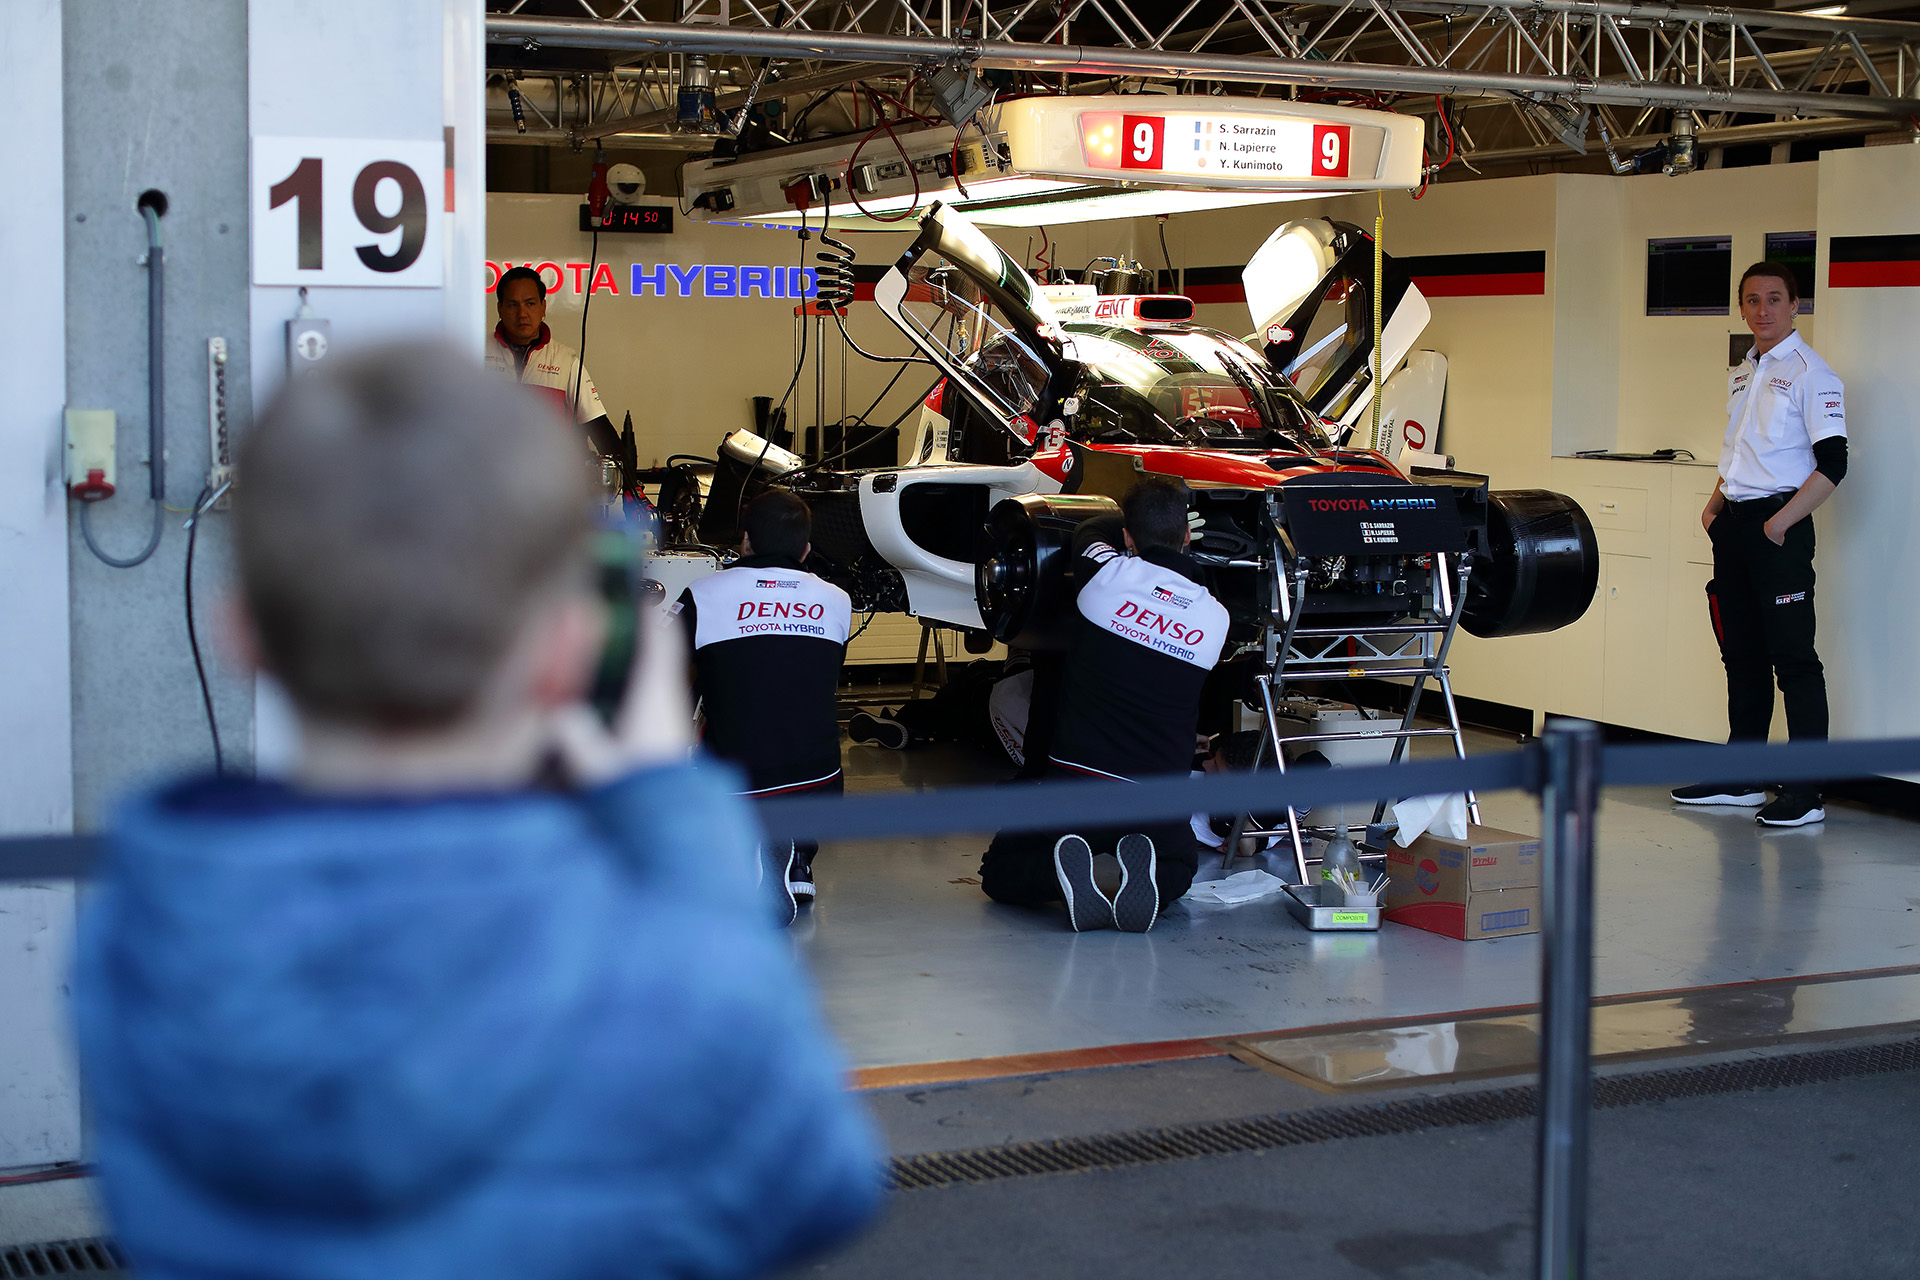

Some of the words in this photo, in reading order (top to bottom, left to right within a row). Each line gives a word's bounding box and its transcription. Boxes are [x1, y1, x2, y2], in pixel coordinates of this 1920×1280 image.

[1219, 124, 1230, 134] S.
[1233, 125, 1276, 136] Sarrazin
[1132, 122, 1154, 162] 9
[1219, 141, 1230, 151] N.
[1233, 142, 1276, 155] Lapierre
[1321, 132, 1341, 170] 9
[1220, 159, 1230, 169] Y.
[1233, 160, 1283, 171] Kunimoto
[269, 157, 427, 273] 19
[644, 211, 659, 223] 50
[629, 262, 821, 298] HYBRID
[1095, 297, 1131, 315] ZENT
[1387, 418, 1395, 438] METAL
[1308, 499, 1369, 512] TOYOTA
[1370, 498, 1437, 510] HYBRID
[737, 602, 824, 620] DENSO
[739, 623, 782, 634] TOYOTA
[784, 623, 825, 635] HYBRID
[1115, 601, 1204, 646] DENSO
[1110, 619, 1150, 644] TOYOTA
[1152, 638, 1195, 661] HYBRID
